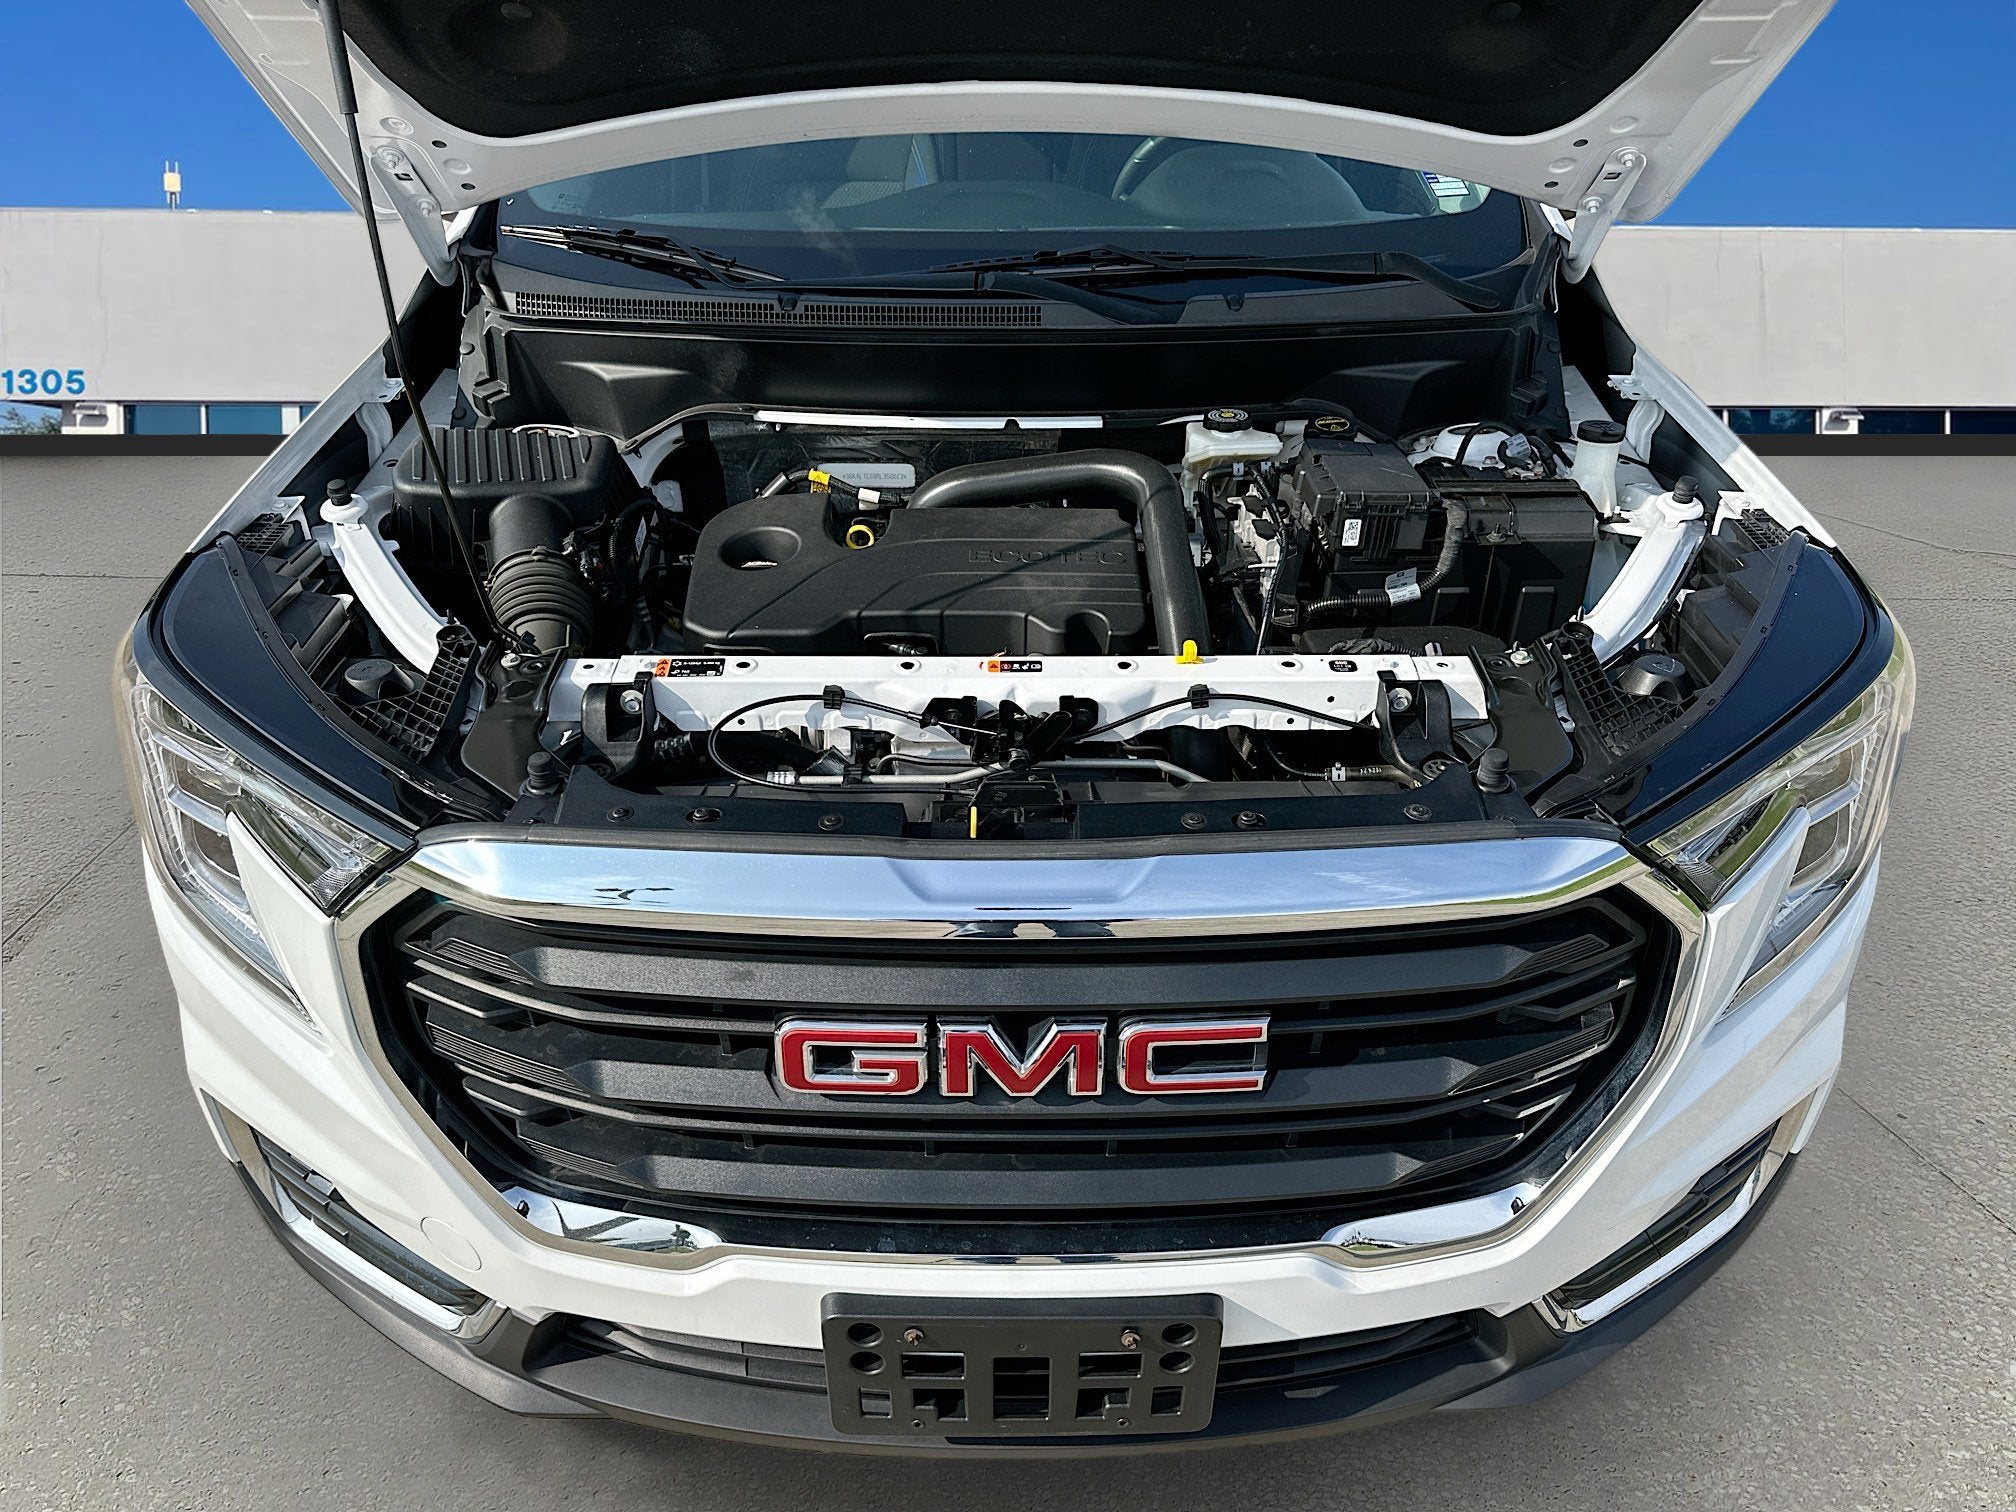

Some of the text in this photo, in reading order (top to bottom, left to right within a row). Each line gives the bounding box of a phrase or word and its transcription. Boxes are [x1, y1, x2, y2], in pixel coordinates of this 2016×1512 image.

[1, 369, 86, 395] 1305
[968, 549, 1128, 564] ECOTEC
[774, 1015, 1271, 1097] GMC
